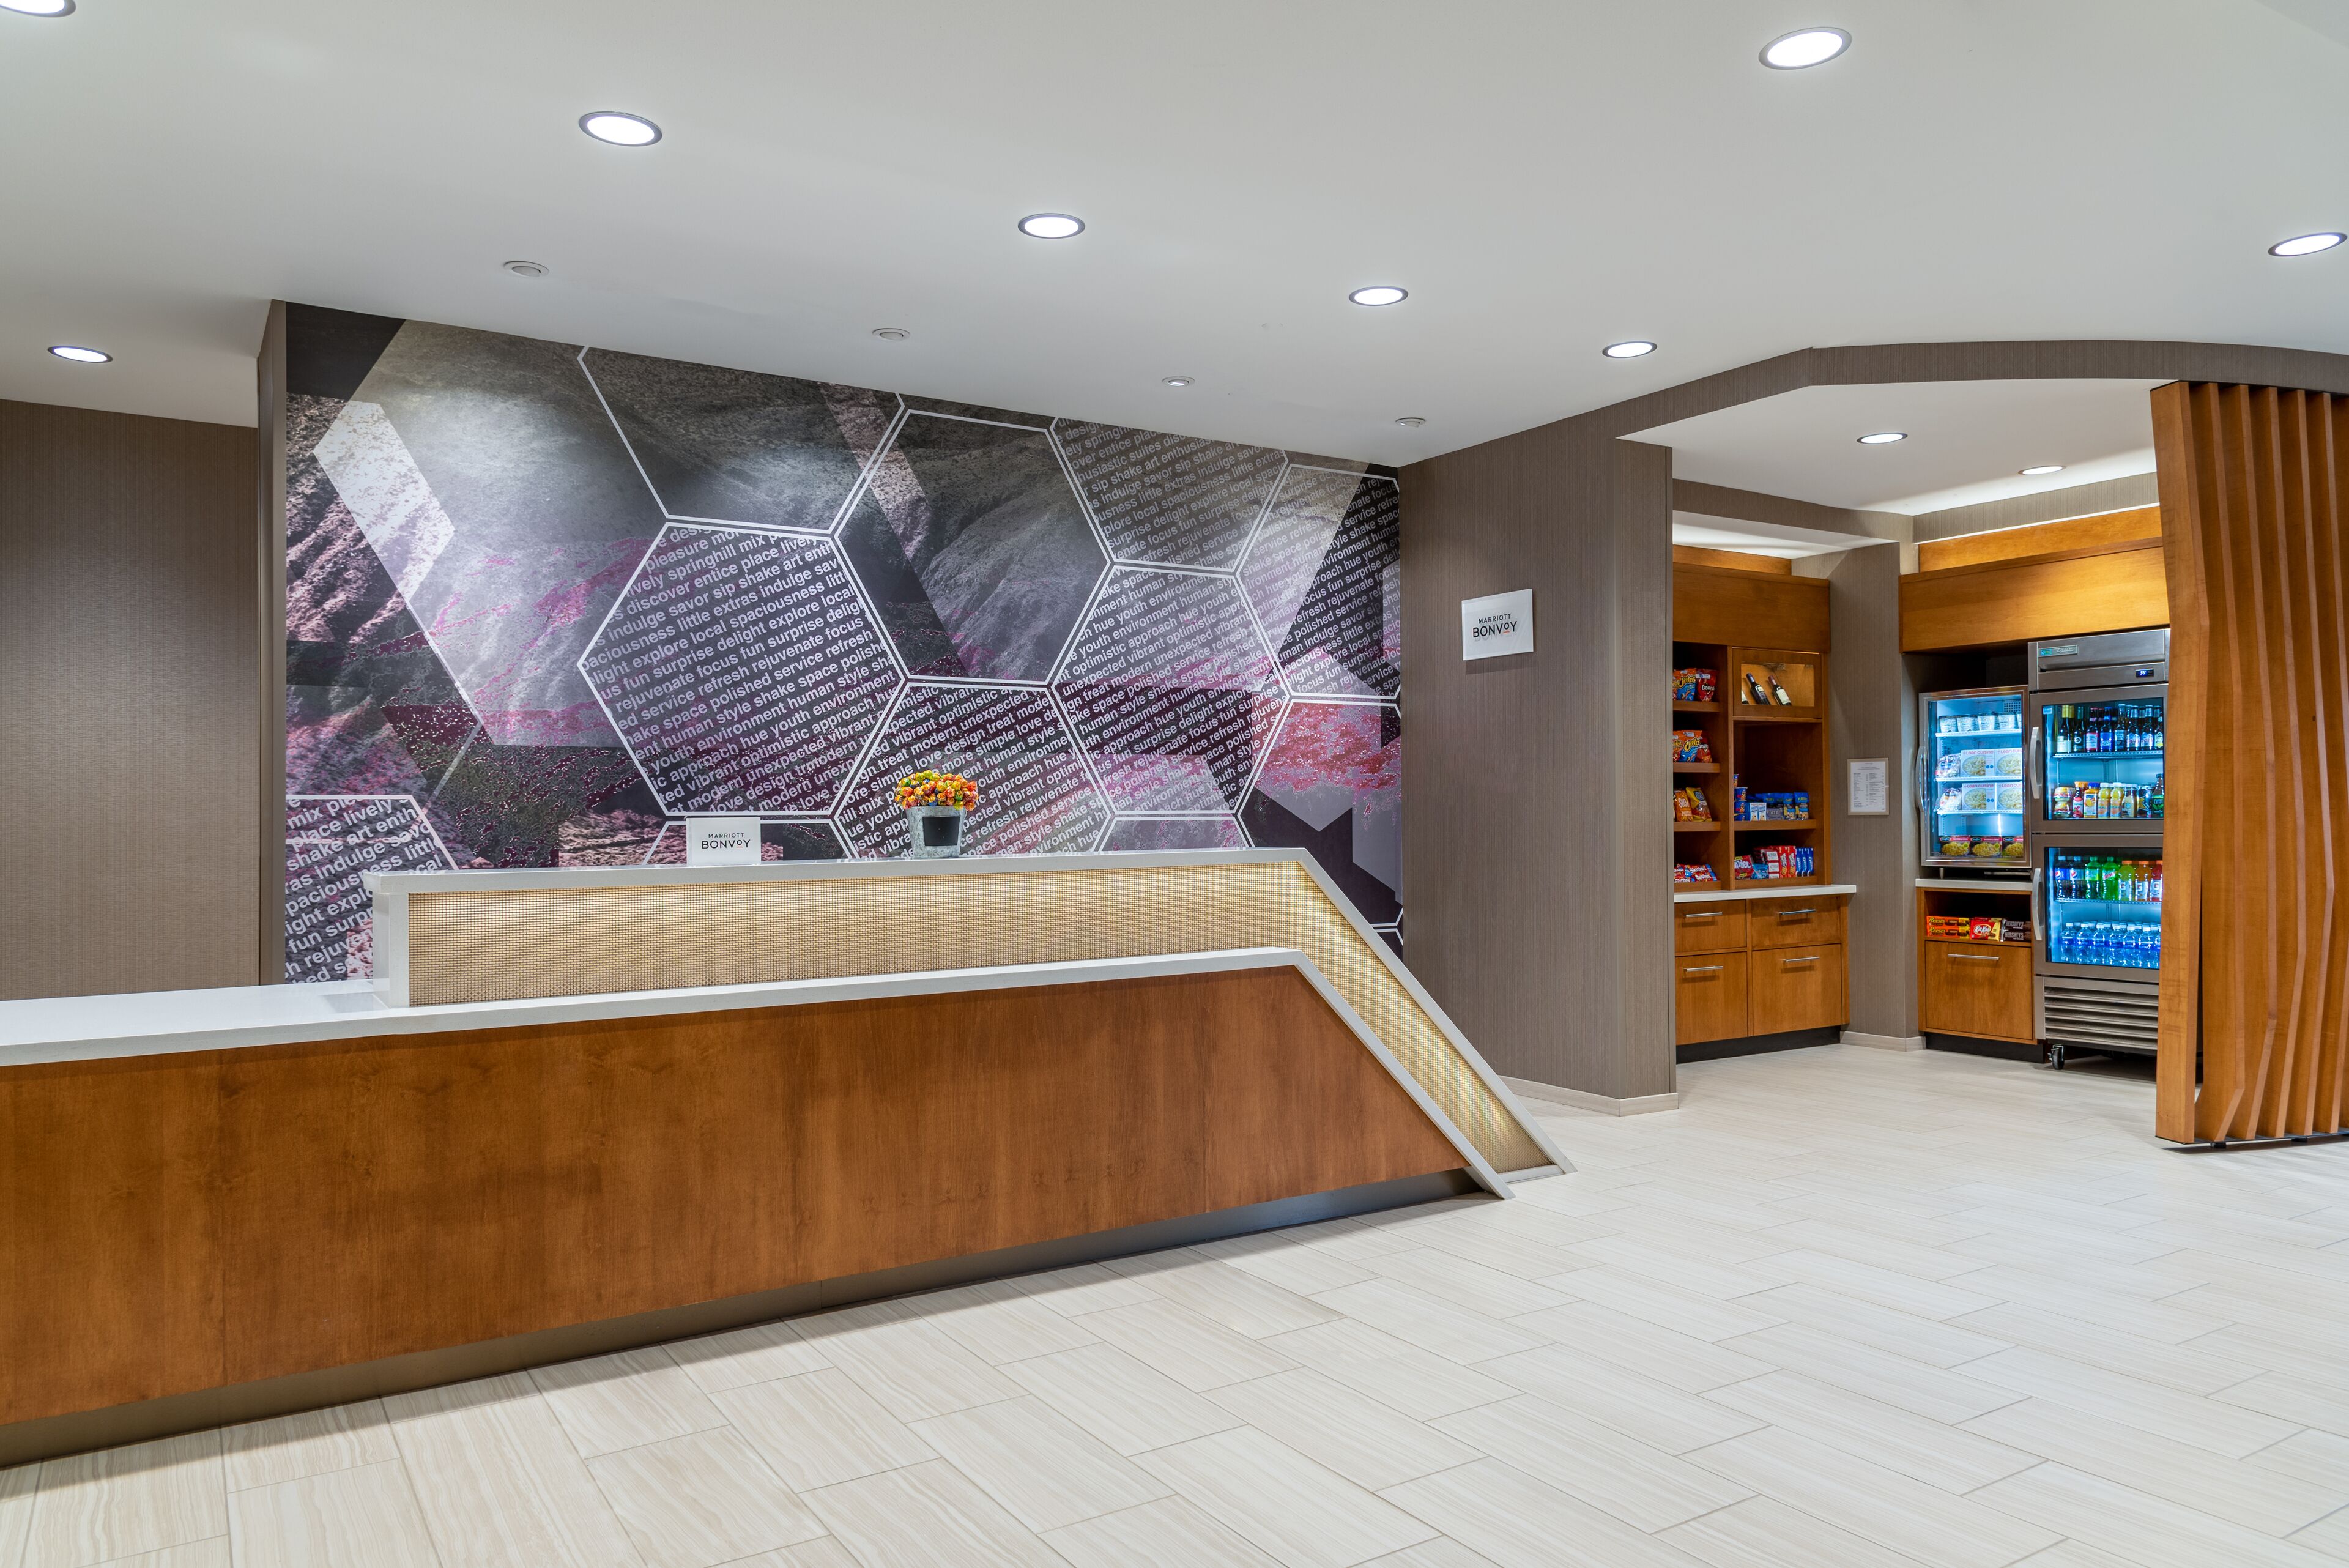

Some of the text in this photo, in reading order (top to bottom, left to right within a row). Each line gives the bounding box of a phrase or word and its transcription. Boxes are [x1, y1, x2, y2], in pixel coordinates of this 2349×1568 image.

[740, 533, 765, 552] mix
[1299, 537, 1387, 592] approach hue youth
[608, 552, 802, 641] indulge savor sip shake art
[626, 547, 778, 614] discover entice place
[1292, 596, 1326, 623] refresh
[1373, 562, 1400, 581] focus
[1294, 573, 1400, 641] polished service refresh
[1299, 558, 1381, 606] focus fun surprise
[623, 582, 854, 690] fun surprise delight explore local
[633, 638, 688, 667] explore
[691, 618, 727, 644] local
[1078, 629, 1110, 658] youth
[1179, 582, 1214, 606] human
[1128, 612, 1177, 647] approach
[1178, 606, 1198, 622] hue
[1200, 587, 1229, 615] youth
[1303, 608, 1366, 647] indulge savor
[1473, 621, 1517, 637] BONVOY
[1479, 614, 1511, 623] MARRIOTT
[642, 691, 695, 719] service
[698, 663, 749, 696] refresh
[825, 617, 863, 640] focus
[1083, 678, 1109, 700] treat
[1111, 659, 1152, 686] modern
[1214, 608, 1249, 634] vibrant
[1092, 623, 1247, 711] space polished service refresh
[1127, 634, 1164, 662] vibrant
[1169, 677, 1206, 703] human
[1207, 663, 1231, 683] style
[1233, 646, 1262, 668] shake
[664, 626, 873, 727] space polished service refresh
[1079, 634, 1255, 734] human style shake space polished
[651, 741, 694, 774] youth
[788, 682, 835, 710] human
[837, 665, 869, 686] style
[670, 740, 738, 781] approach
[741, 731, 768, 749] hue
[772, 707, 811, 740] youth
[688, 759, 740, 792] vibrant
[812, 694, 874, 734] approach
[892, 716, 936, 746] vibrant
[689, 776, 744, 809] modern
[829, 712, 875, 743] vibrant
[859, 716, 1041, 813] mix more simple love
[872, 710, 1015, 790] simple love design treat
[877, 745, 908, 769] treat
[911, 724, 959, 754] modern
[984, 726, 1056, 769] human style
[745, 770, 793, 798] design
[759, 779, 811, 811] modern
[989, 753, 1067, 798] approach hue
[288, 808, 321, 829] mix
[292, 798, 394, 850] place lively
[702, 839, 751, 849] BONVOY
[976, 806, 1018, 838] refresh
[288, 841, 343, 869] shake
[348, 824, 373, 844] art
[316, 842, 385, 879] indulge
[289, 931, 321, 953] fun
